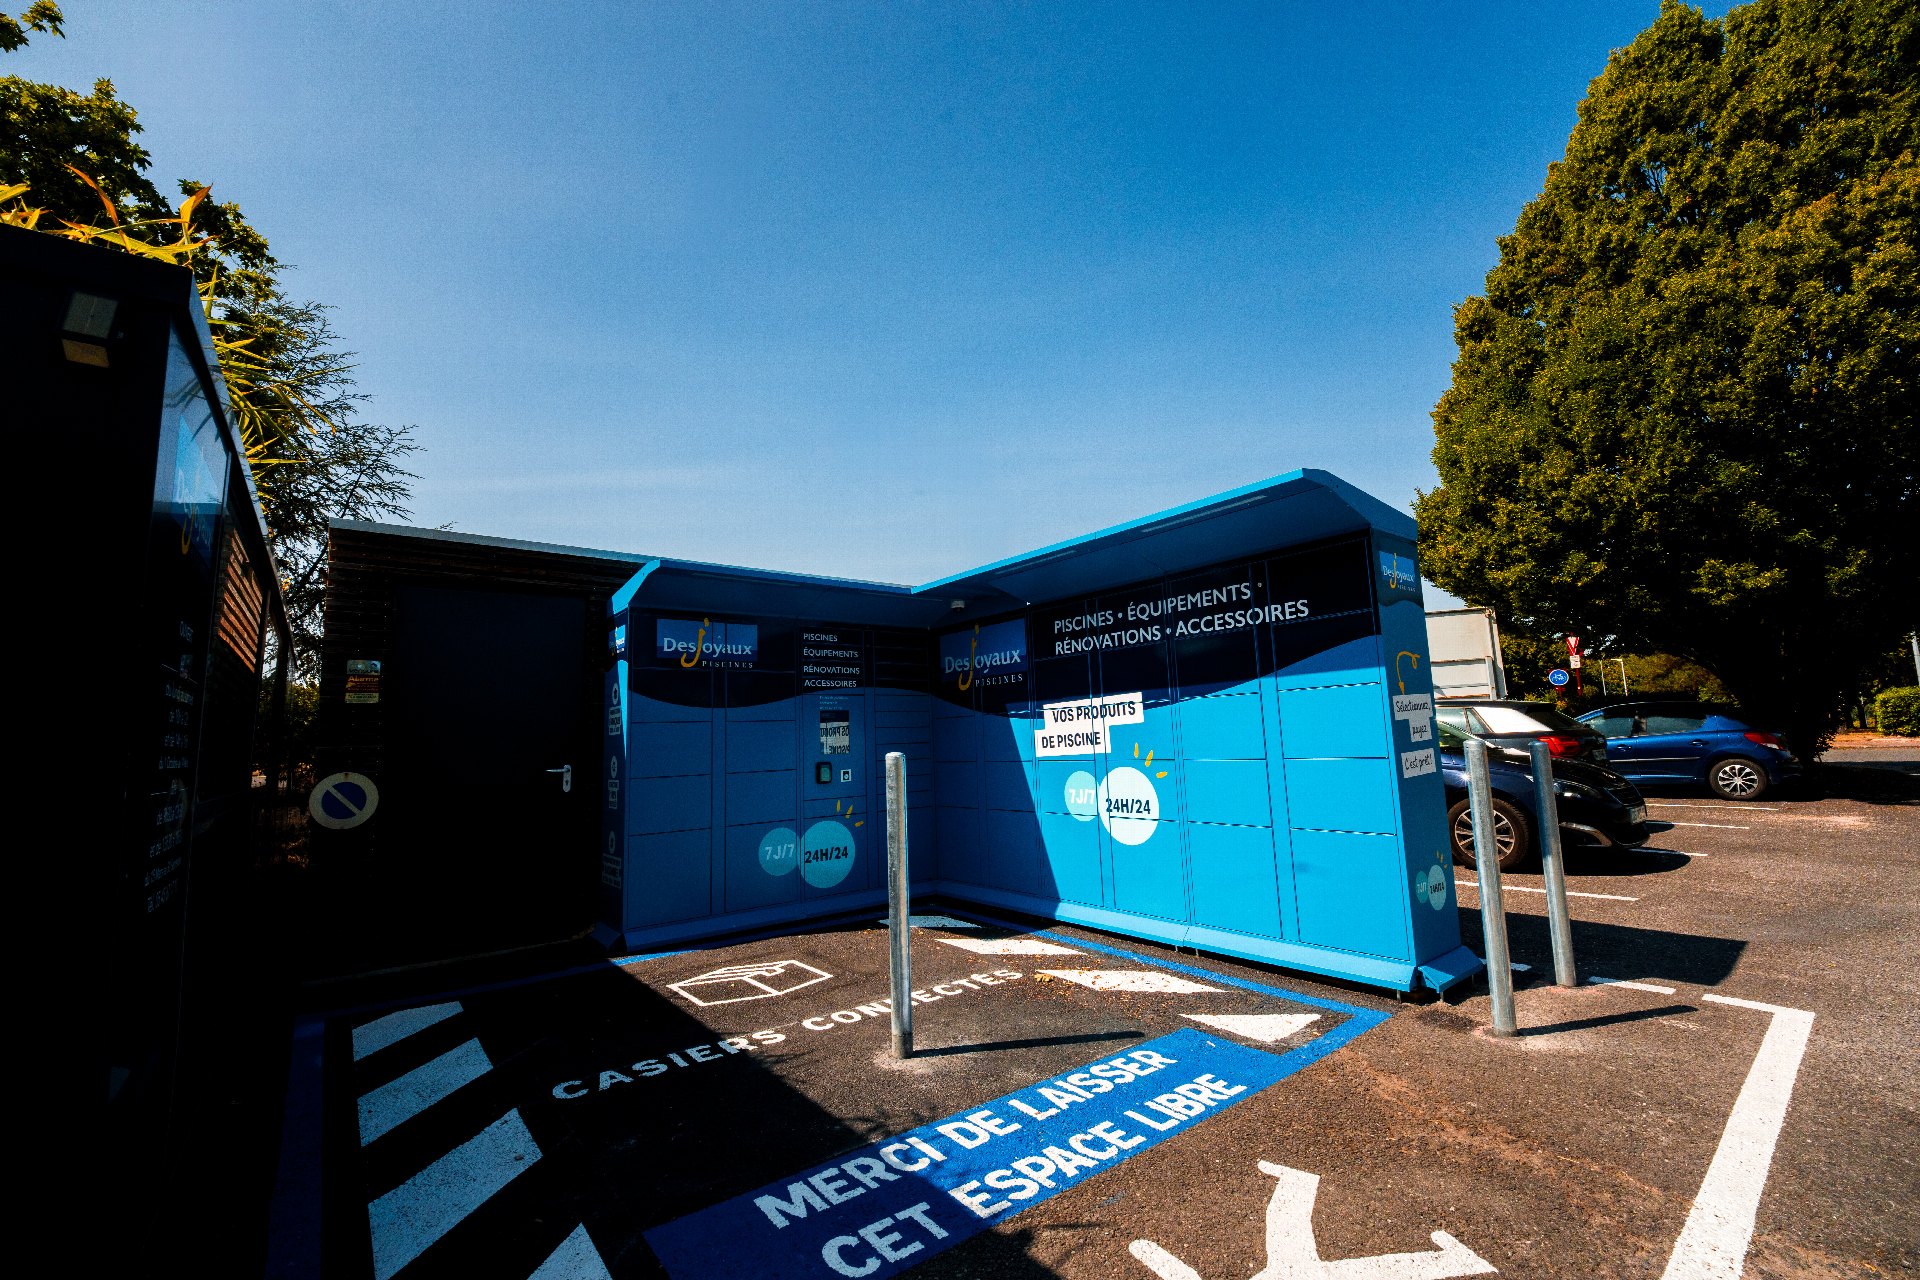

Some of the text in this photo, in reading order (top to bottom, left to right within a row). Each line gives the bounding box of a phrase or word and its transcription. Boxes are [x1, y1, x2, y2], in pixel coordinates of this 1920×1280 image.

[1054, 582, 1251, 635] PISCINES ÉQUIPEMENTS
[1055, 599, 1310, 656] RÉNOVATIONS ACCESSOIRES
[803, 632, 838, 642] PISCINES
[803, 646, 859, 658] ÉQUIPEMENTS
[701, 660, 753, 669] PISCINES
[803, 663, 861, 675] RÉNOVATIONS
[804, 679, 857, 688] ACCESSOIRES
[975, 673, 1023, 688] PISCINES
[1051, 700, 1136, 723] VOS PRODUITS
[1041, 731, 1101, 749] DE PISCINE
[1068, 788, 1095, 805] 7J/7
[1105, 798, 1151, 815] 24H/24
[764, 843, 795, 861] 7J/7
[804, 845, 848, 864] 24H/24
[551, 1029, 787, 1100] CASIERS
[753, 1050, 1179, 1230] MERCI DE LAISSER
[821, 1073, 1248, 1279] CET ESPACE LIBRE
